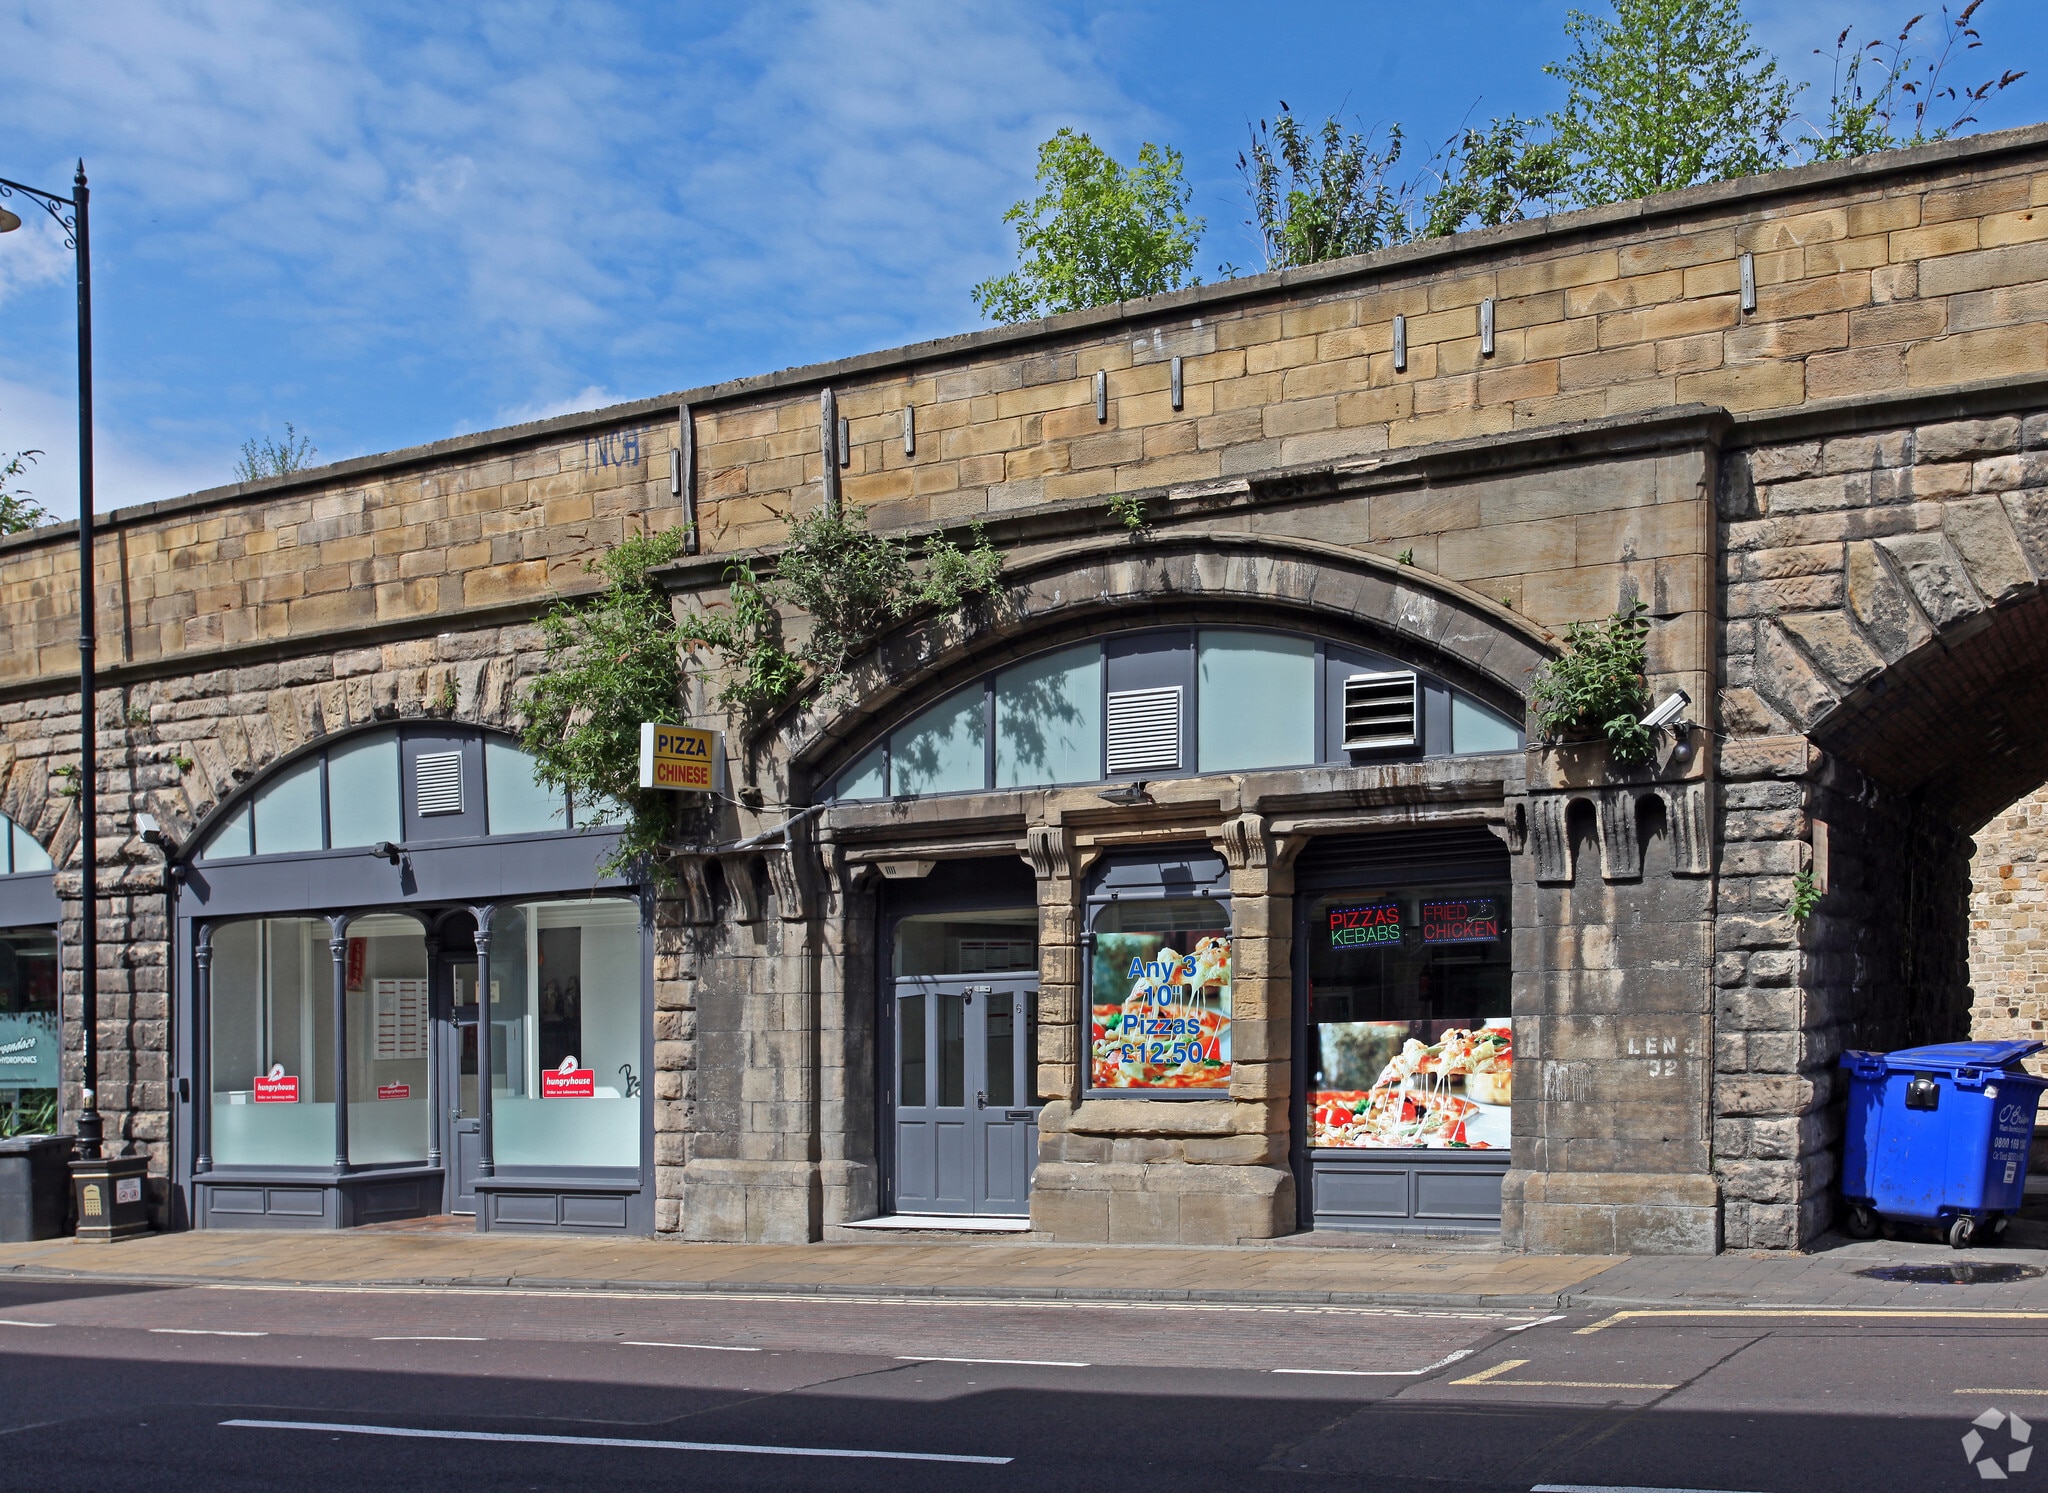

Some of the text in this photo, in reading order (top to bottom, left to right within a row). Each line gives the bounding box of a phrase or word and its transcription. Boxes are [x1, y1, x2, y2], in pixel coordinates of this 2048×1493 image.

[658, 734, 707, 757] PIZZA
[657, 763, 708, 785] CHINESE
[1330, 907, 1399, 930] PIZZAS
[1423, 904, 1468, 921] FRIED
[1331, 924, 1400, 946] KEBABS
[1424, 920, 1498, 940] CHICKEN
[1127, 956, 1197, 983] Any 3
[1123, 1014, 1200, 1035] Pizzas
[1121, 1042, 1203, 1063] £12.50
[257, 1083, 295, 1092] hungryhouse
[546, 1076, 591, 1087] hungryhouse
[1994, 1137, 2010, 1148] 0800
